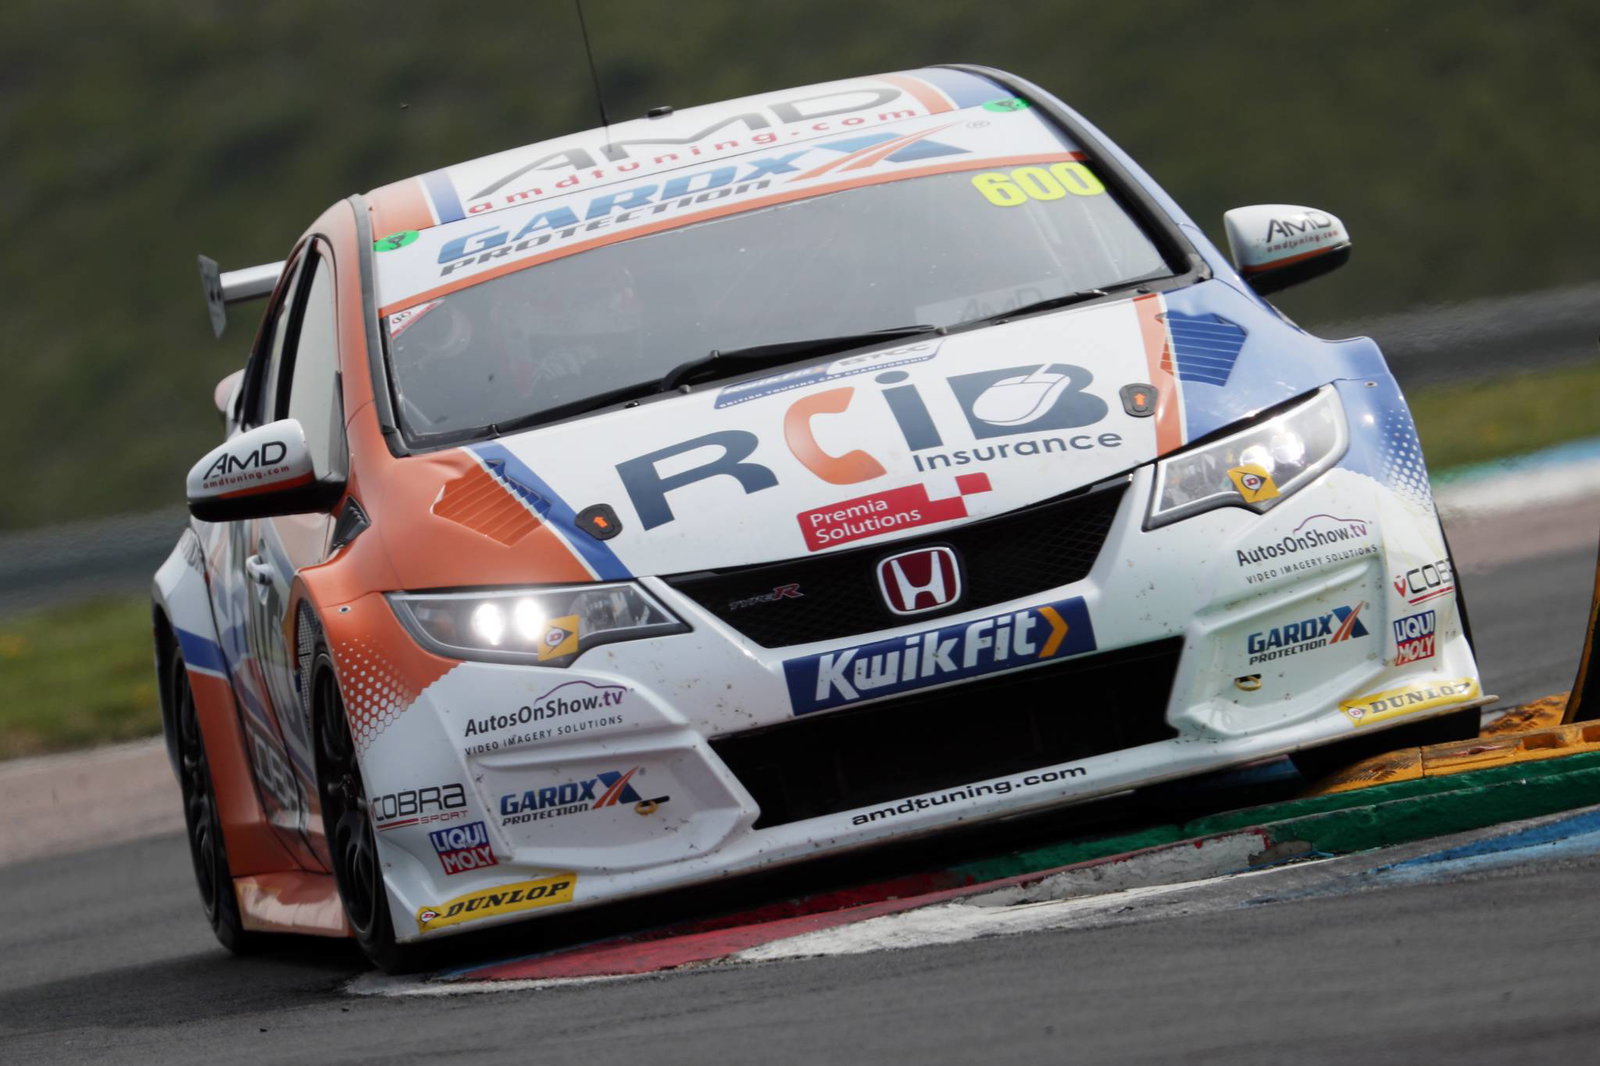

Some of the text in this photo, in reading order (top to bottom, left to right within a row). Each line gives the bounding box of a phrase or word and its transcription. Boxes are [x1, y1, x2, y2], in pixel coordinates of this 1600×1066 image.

[466, 85, 904, 202] AMD
[971, 161, 1106, 207] 600
[440, 178, 771, 277] PROTECTION
[1266, 211, 1332, 243] AMD
[1266, 230, 1340, 253] amdtuning.com
[203, 440, 288, 480] AMD
[912, 430, 1123, 472] Insurance
[202, 465, 290, 489] amdtuning.com
[809, 499, 888, 528] Premia
[815, 506, 921, 544] Solutions
[1236, 523, 1368, 567] AutosOnShow.tv
[1246, 543, 1378, 584] VIDEO IMAGERY SOLUTIONS
[1395, 612, 1435, 643] LIQUI
[1249, 639, 1327, 665] PROTECTION
[1396, 635, 1434, 665] MOLY
[464, 690, 625, 737] AutosOnShow.tv
[464, 714, 624, 756] VIDEO IMAGERY SOLUTIONS
[502, 802, 589, 827] PROTECTION
[851, 765, 1087, 826] amdtuning.com
[420, 809, 469, 825] SPORT
[431, 823, 487, 852] LIQUI
[441, 846, 498, 874] MOLY
[442, 880, 571, 919] DUNLOP
